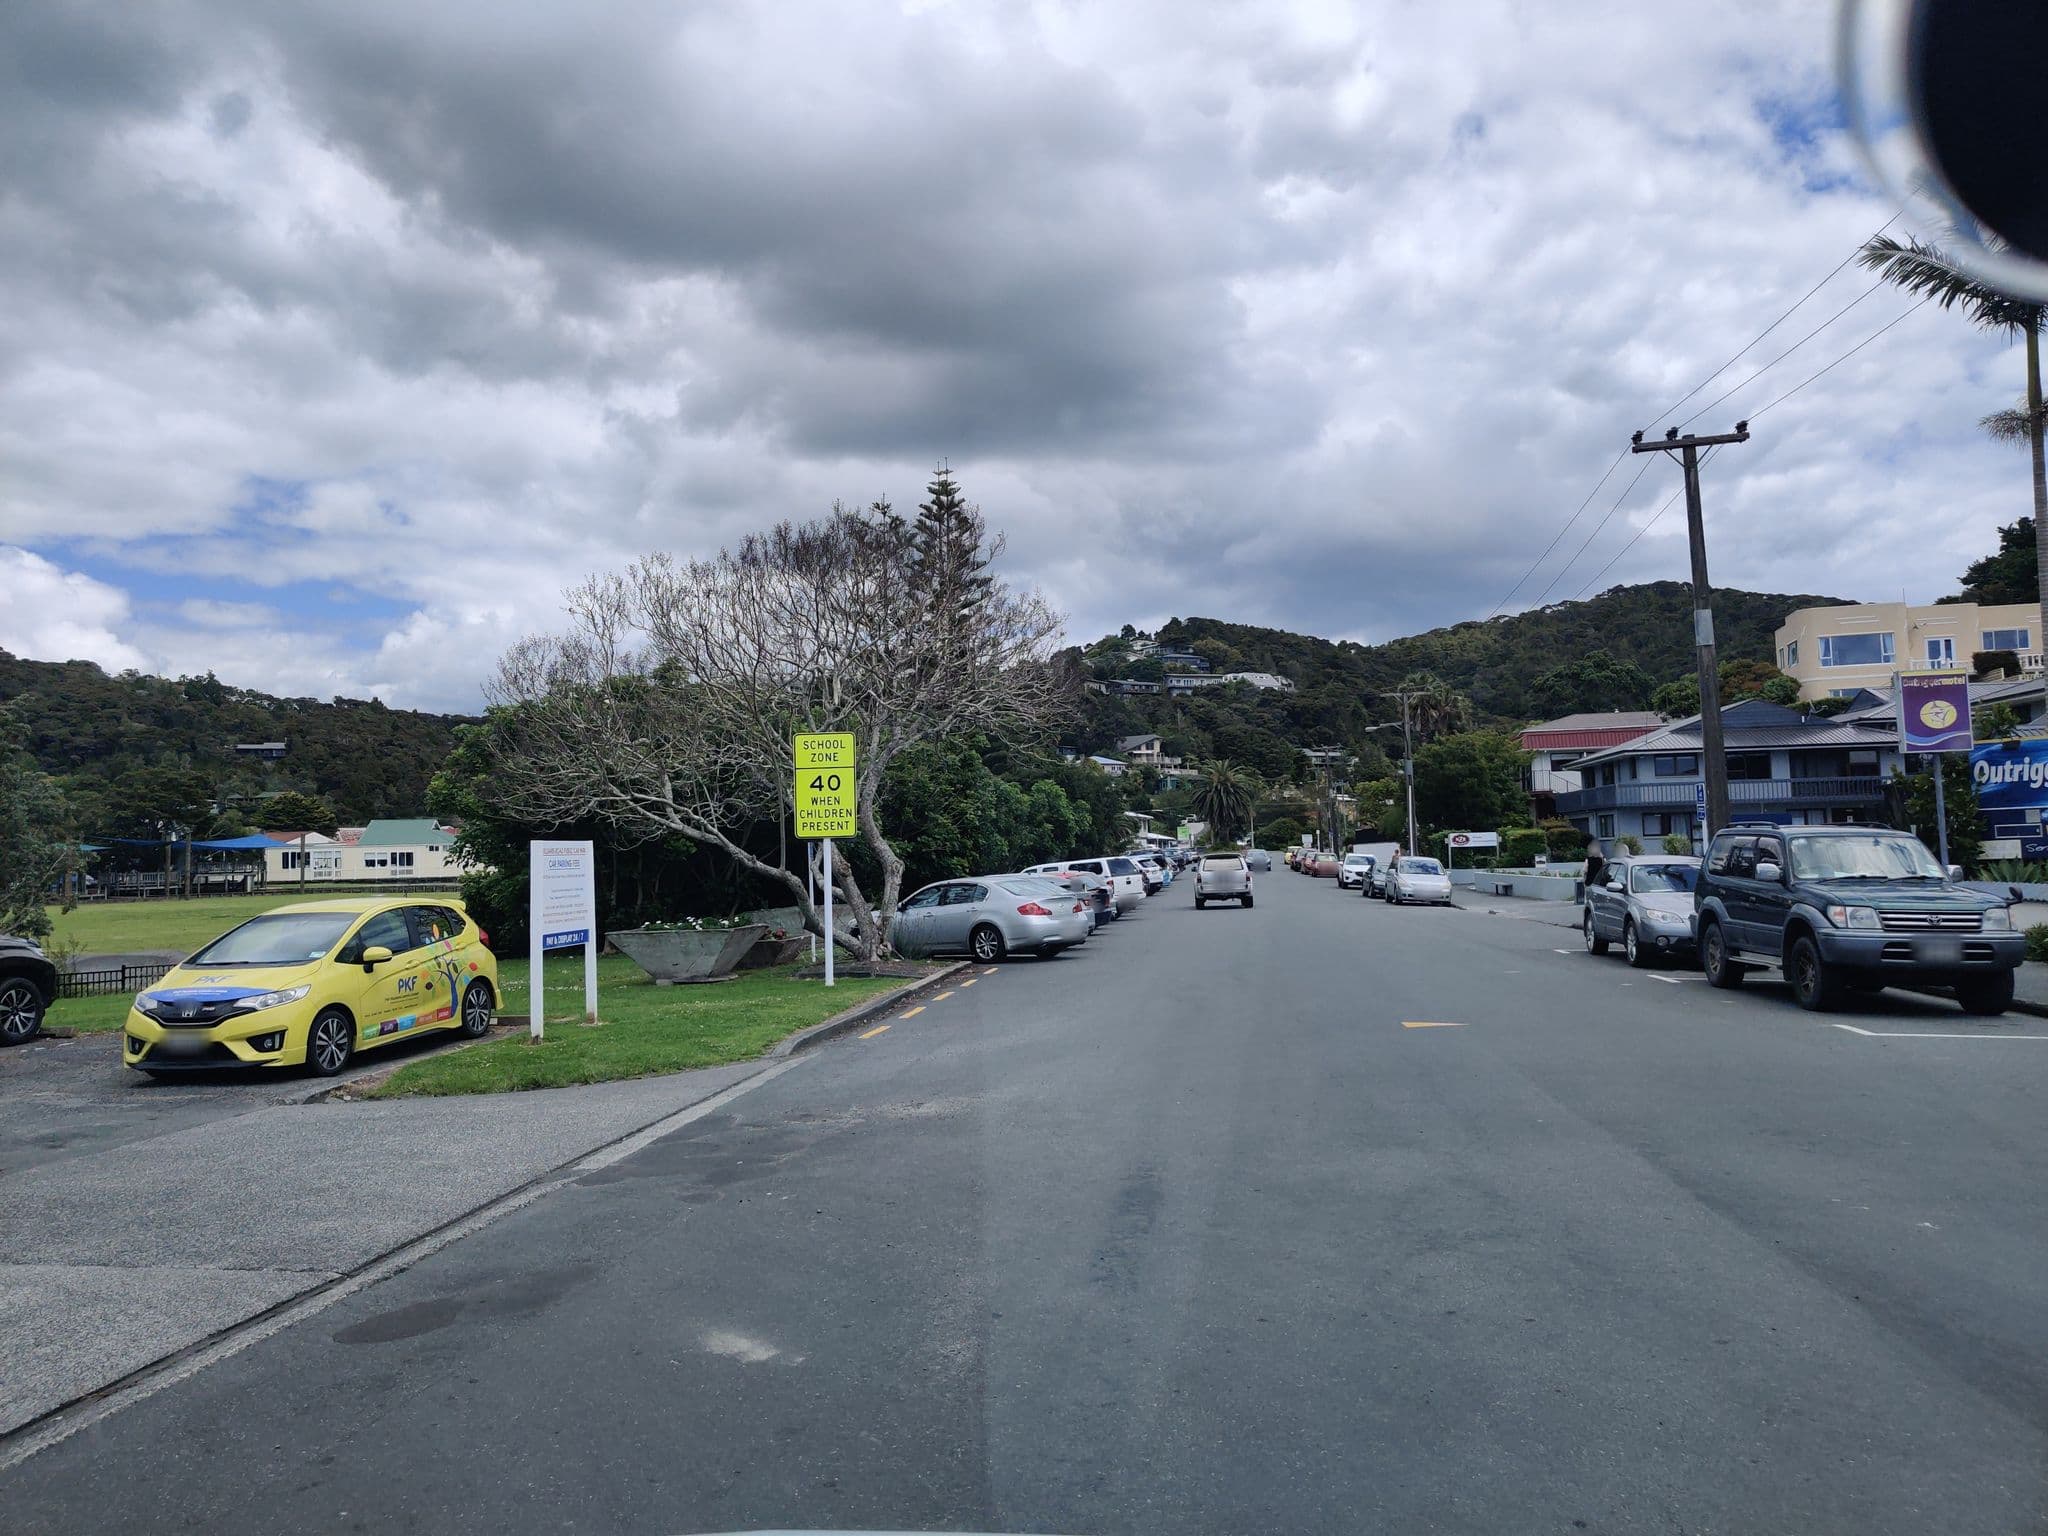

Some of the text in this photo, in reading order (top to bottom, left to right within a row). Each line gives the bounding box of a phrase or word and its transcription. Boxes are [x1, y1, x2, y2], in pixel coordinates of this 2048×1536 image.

[803, 740, 846, 750] SCHOOL
[810, 753, 839, 762] ZONE
[810, 774, 841, 791] 40
[811, 796, 840, 806] WHEN
[799, 808, 853, 819] CHILDREN
[802, 821, 849, 831] PRESENT
[546, 936, 554, 946] PAY
[397, 975, 418, 993] PKF
